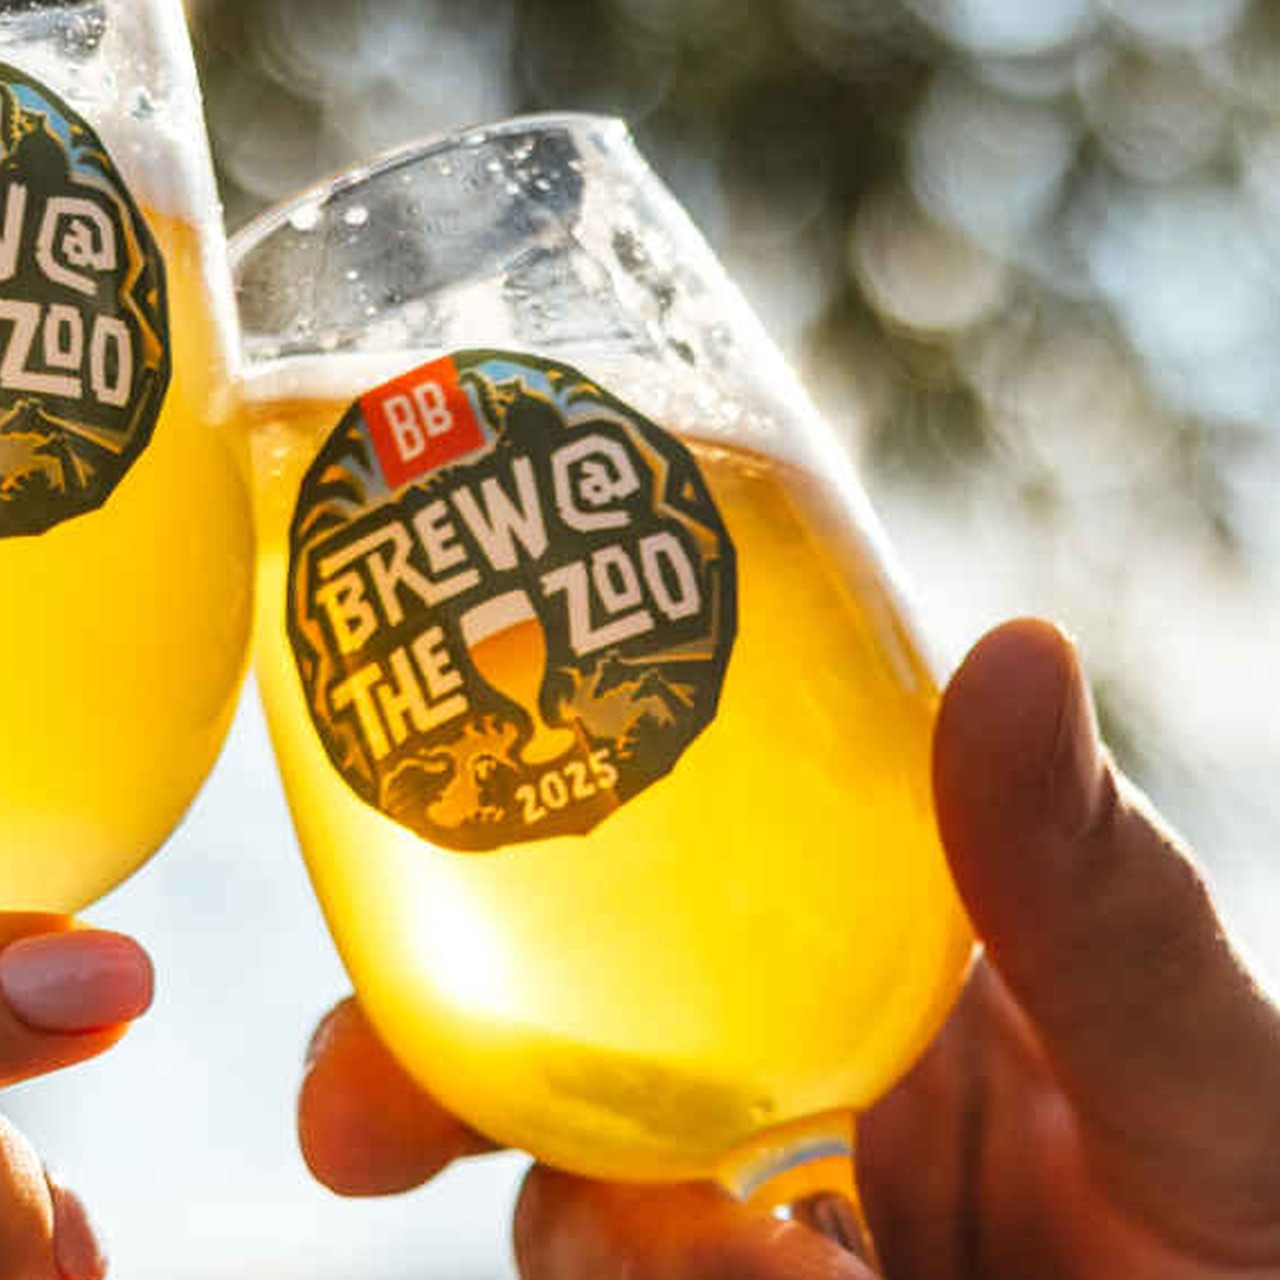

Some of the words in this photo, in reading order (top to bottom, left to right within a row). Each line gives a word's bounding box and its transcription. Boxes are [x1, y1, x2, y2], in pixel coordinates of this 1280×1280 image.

[384, 380, 453, 464] BB
[331, 626, 469, 762] THE
[540, 530, 702, 657] ZOO
[515, 748, 618, 824] 2025
